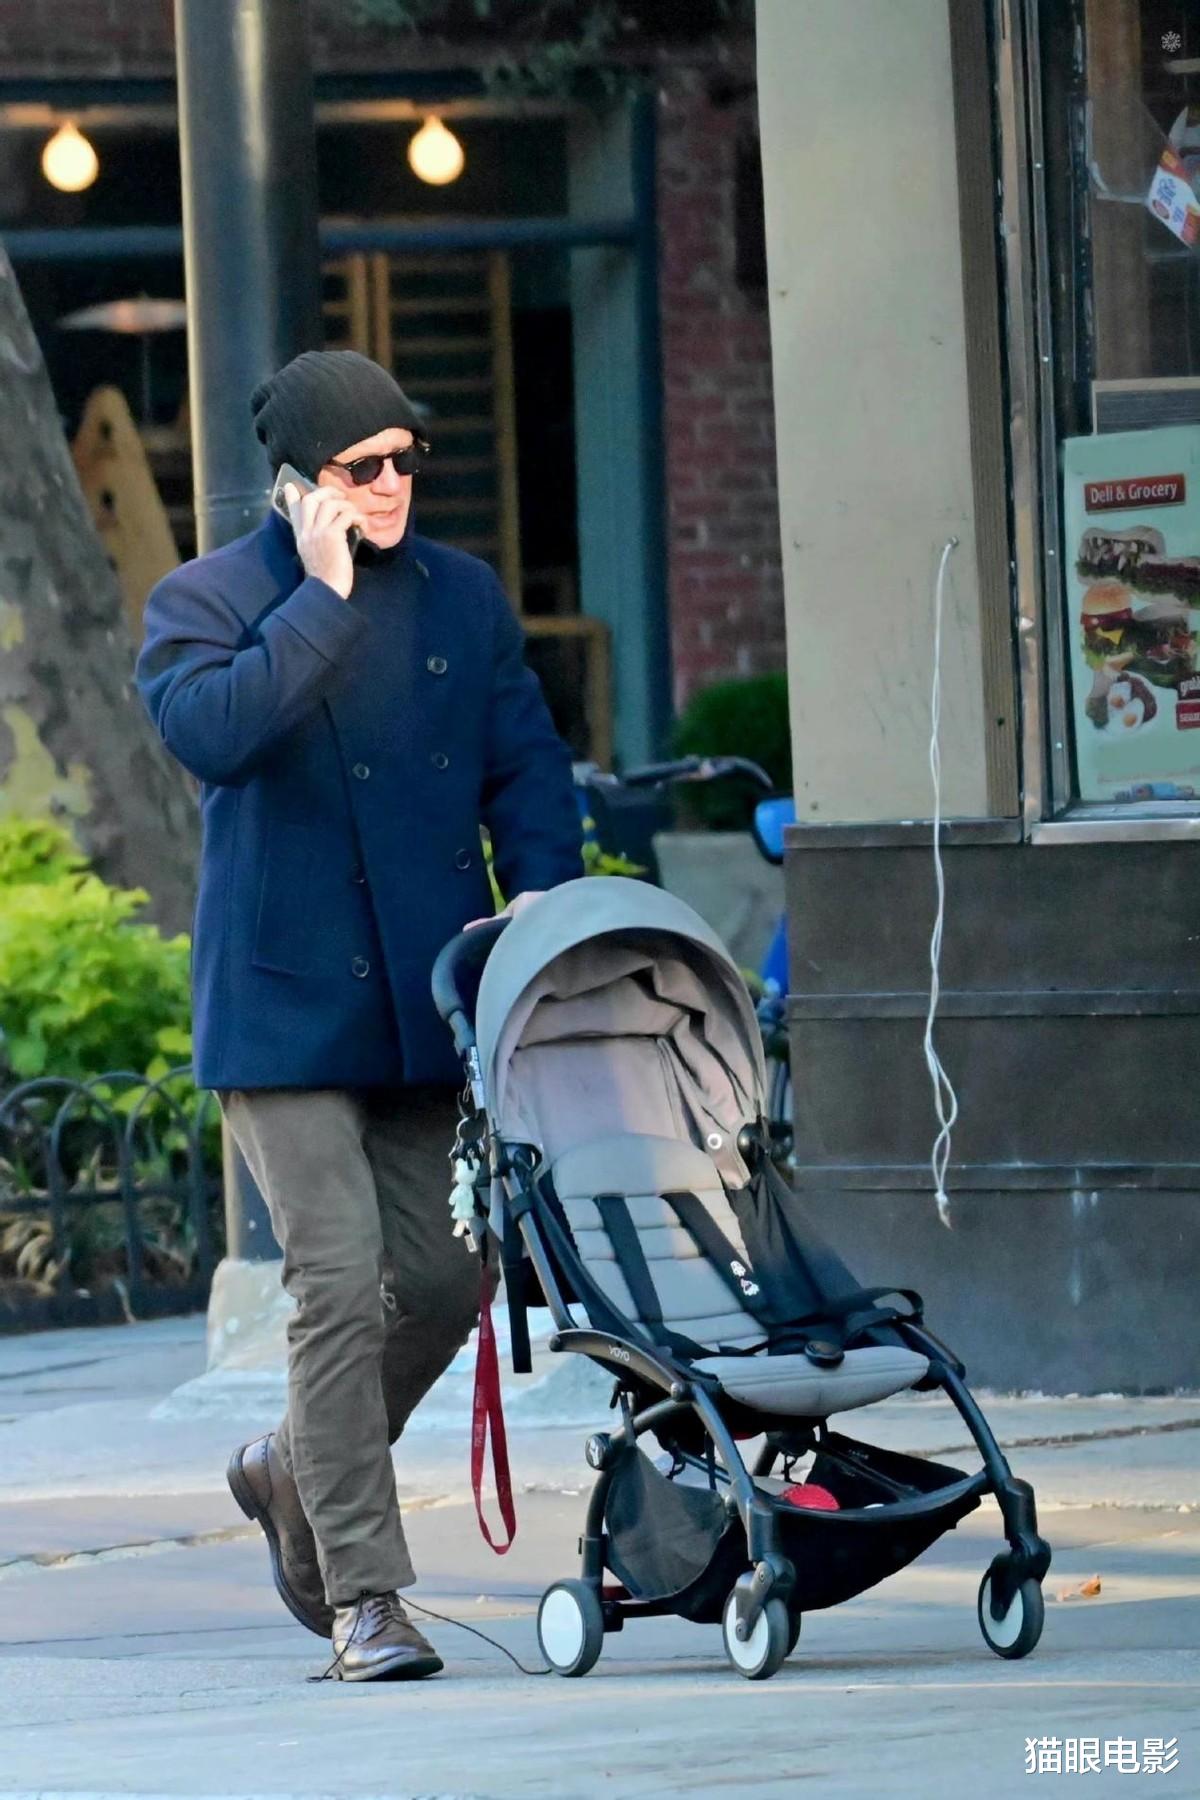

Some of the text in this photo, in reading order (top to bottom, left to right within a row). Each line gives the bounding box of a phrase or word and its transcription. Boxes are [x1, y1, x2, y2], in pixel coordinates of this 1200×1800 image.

[1090, 482, 1178, 503] Deli & Grocery
